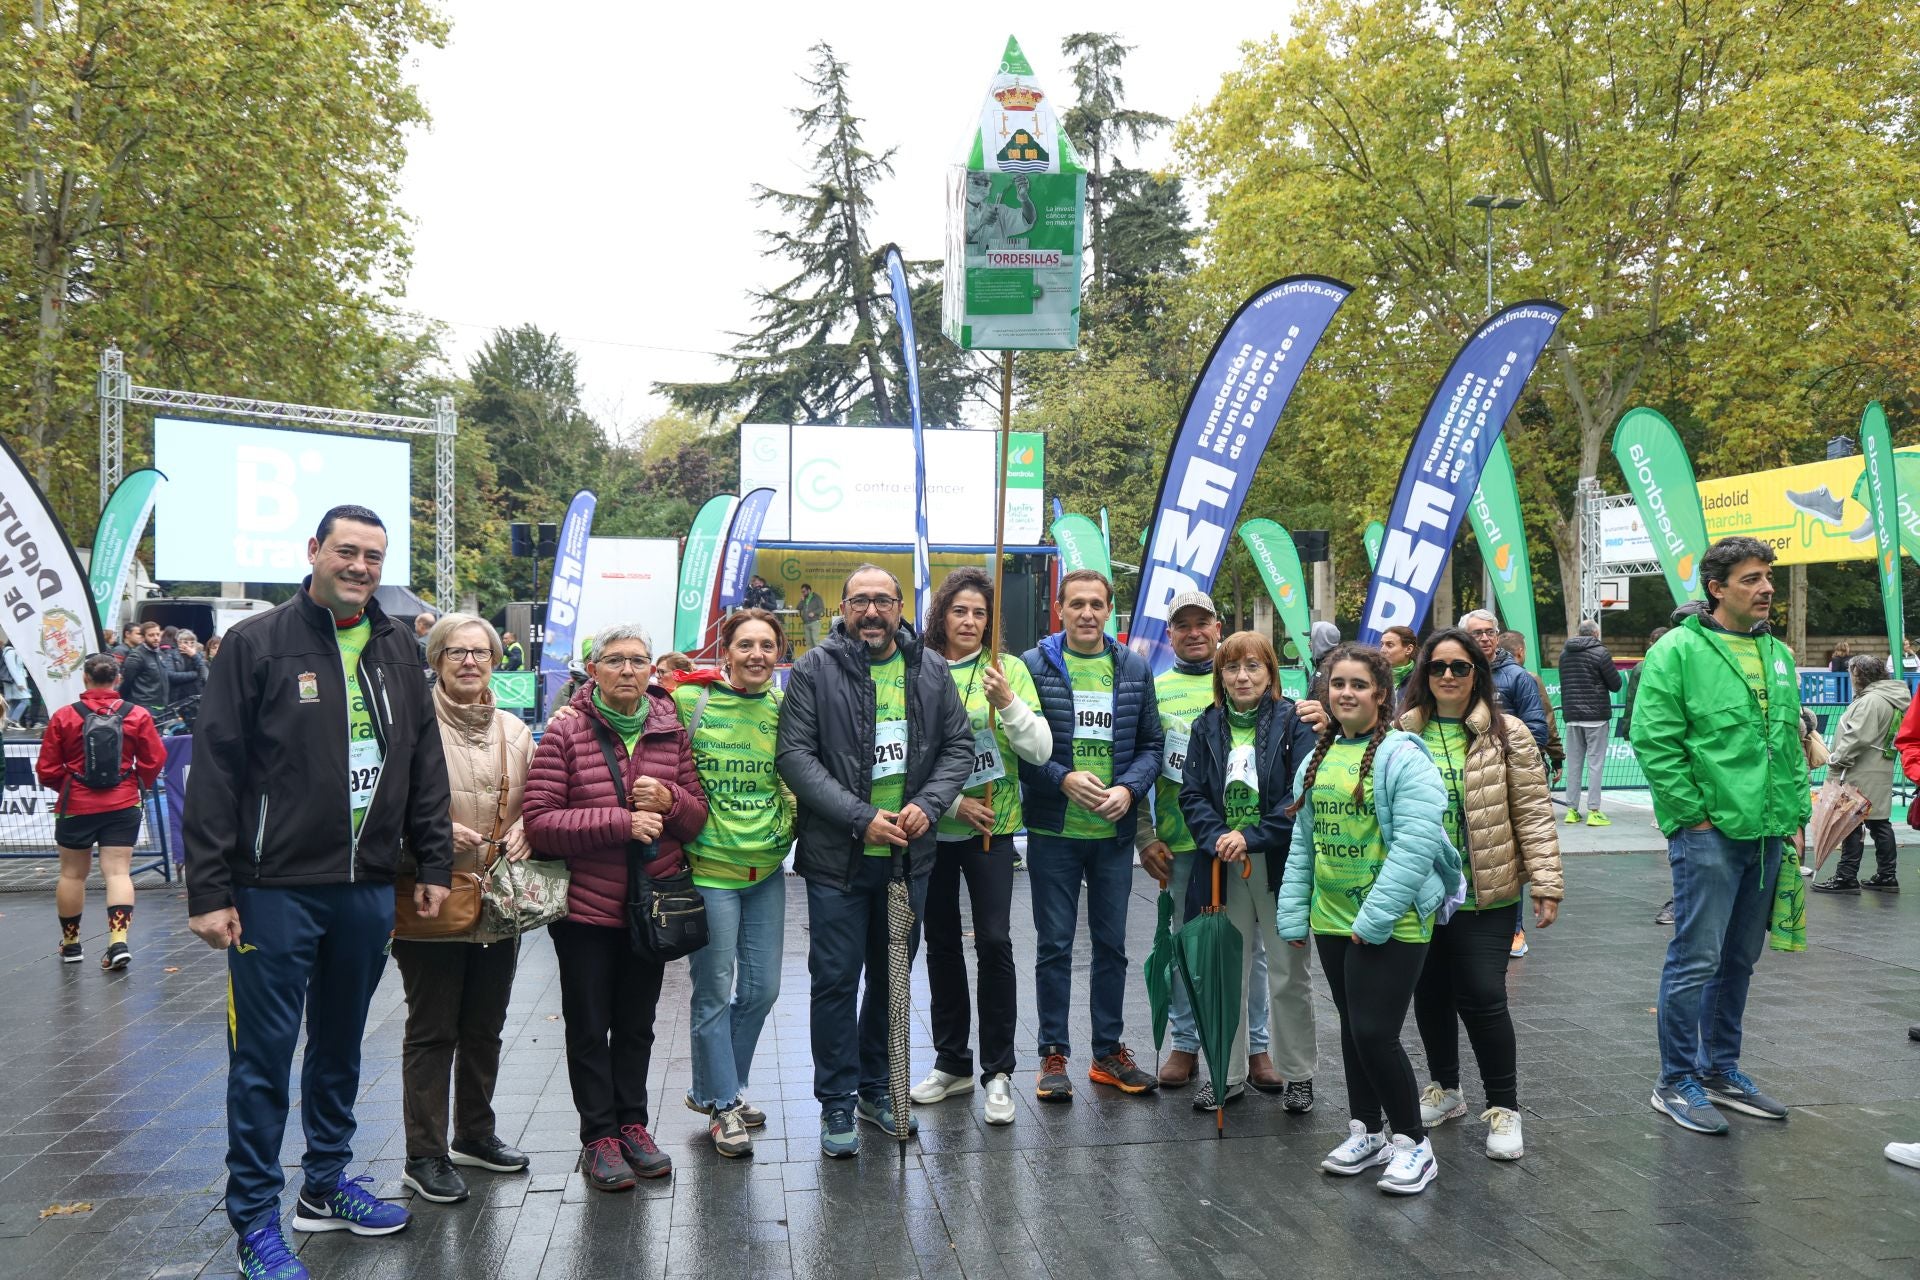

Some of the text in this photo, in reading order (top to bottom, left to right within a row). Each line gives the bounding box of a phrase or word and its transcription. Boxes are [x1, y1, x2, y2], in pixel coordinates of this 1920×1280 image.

[987, 253, 1060, 265] TORDESILLAS
[1253, 282, 1344, 310] www.fmdva.org
[1477, 308, 1558, 340] www.fmdva.org
[1197, 343, 1254, 448] Fundación
[1213, 349, 1268, 455] Municipal
[1229, 324, 1300, 460] de Deportes
[1449, 350, 1518, 484] de Deportes
[1422, 372, 1475, 473] Fundación
[1436, 376, 1488, 479] Municipal
[926, 483, 965, 495] ancer
[550, 555, 582, 627] FMD
[721, 540, 742, 597] FMD
[710, 742, 751, 750] Valladolid
[1077, 710, 1112, 729] 1940
[1168, 751, 1186, 770] 45
